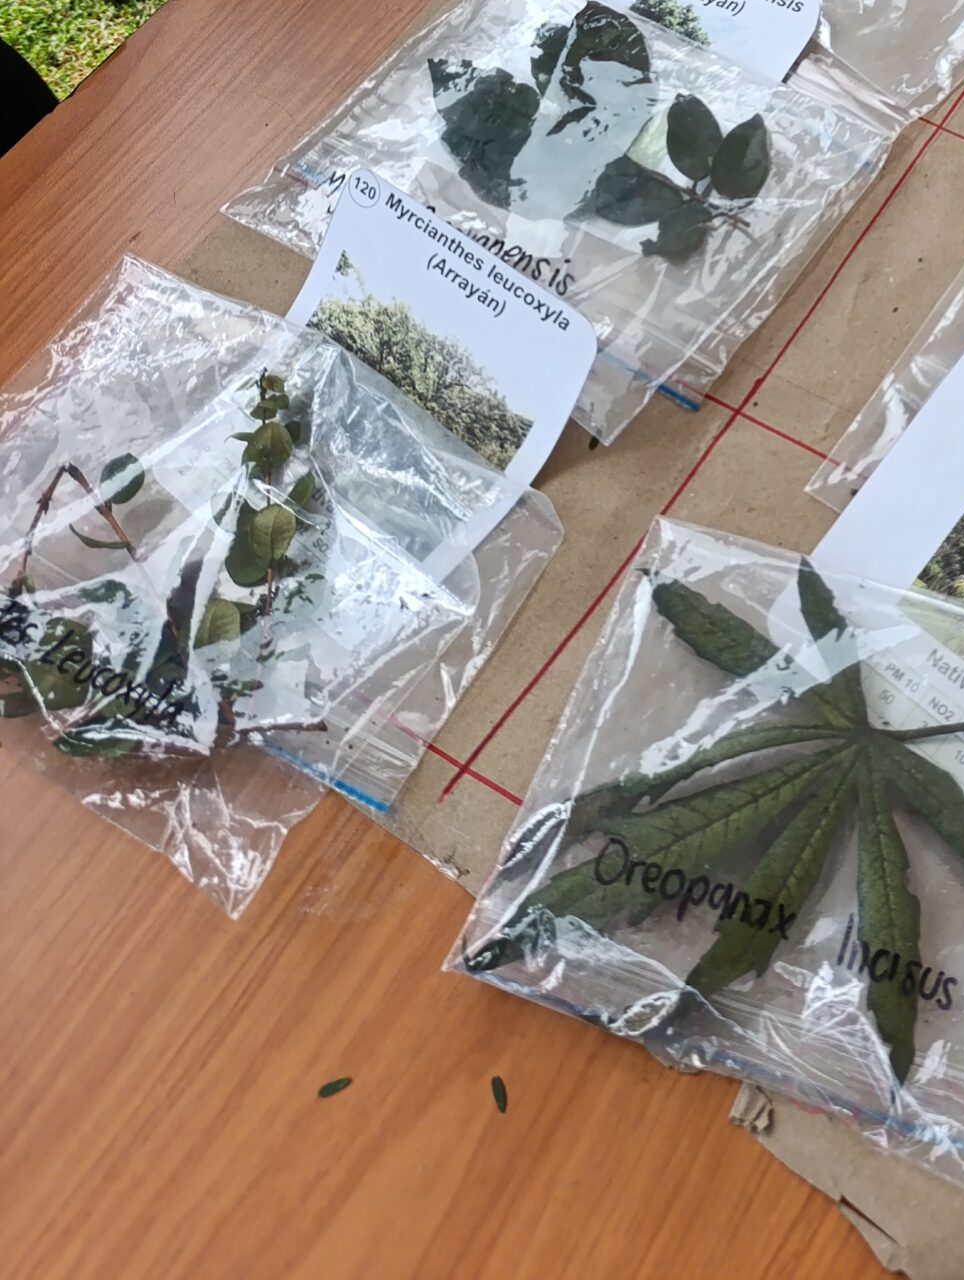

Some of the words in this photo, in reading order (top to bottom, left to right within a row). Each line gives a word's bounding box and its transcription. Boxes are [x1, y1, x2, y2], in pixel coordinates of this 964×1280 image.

[353, 176, 378, 201] 120
[385, 192, 486, 272] Myrcianthes
[486, 264, 571, 332] leucoxyla
[426, 252, 508, 319] (Arrayán)
[885, 663, 905, 682] PM
[905, 677, 920, 693] 10
[879, 689, 896, 705] 50
[928, 696, 956, 721] NO2
[594, 837, 797, 940] Oreopanax
